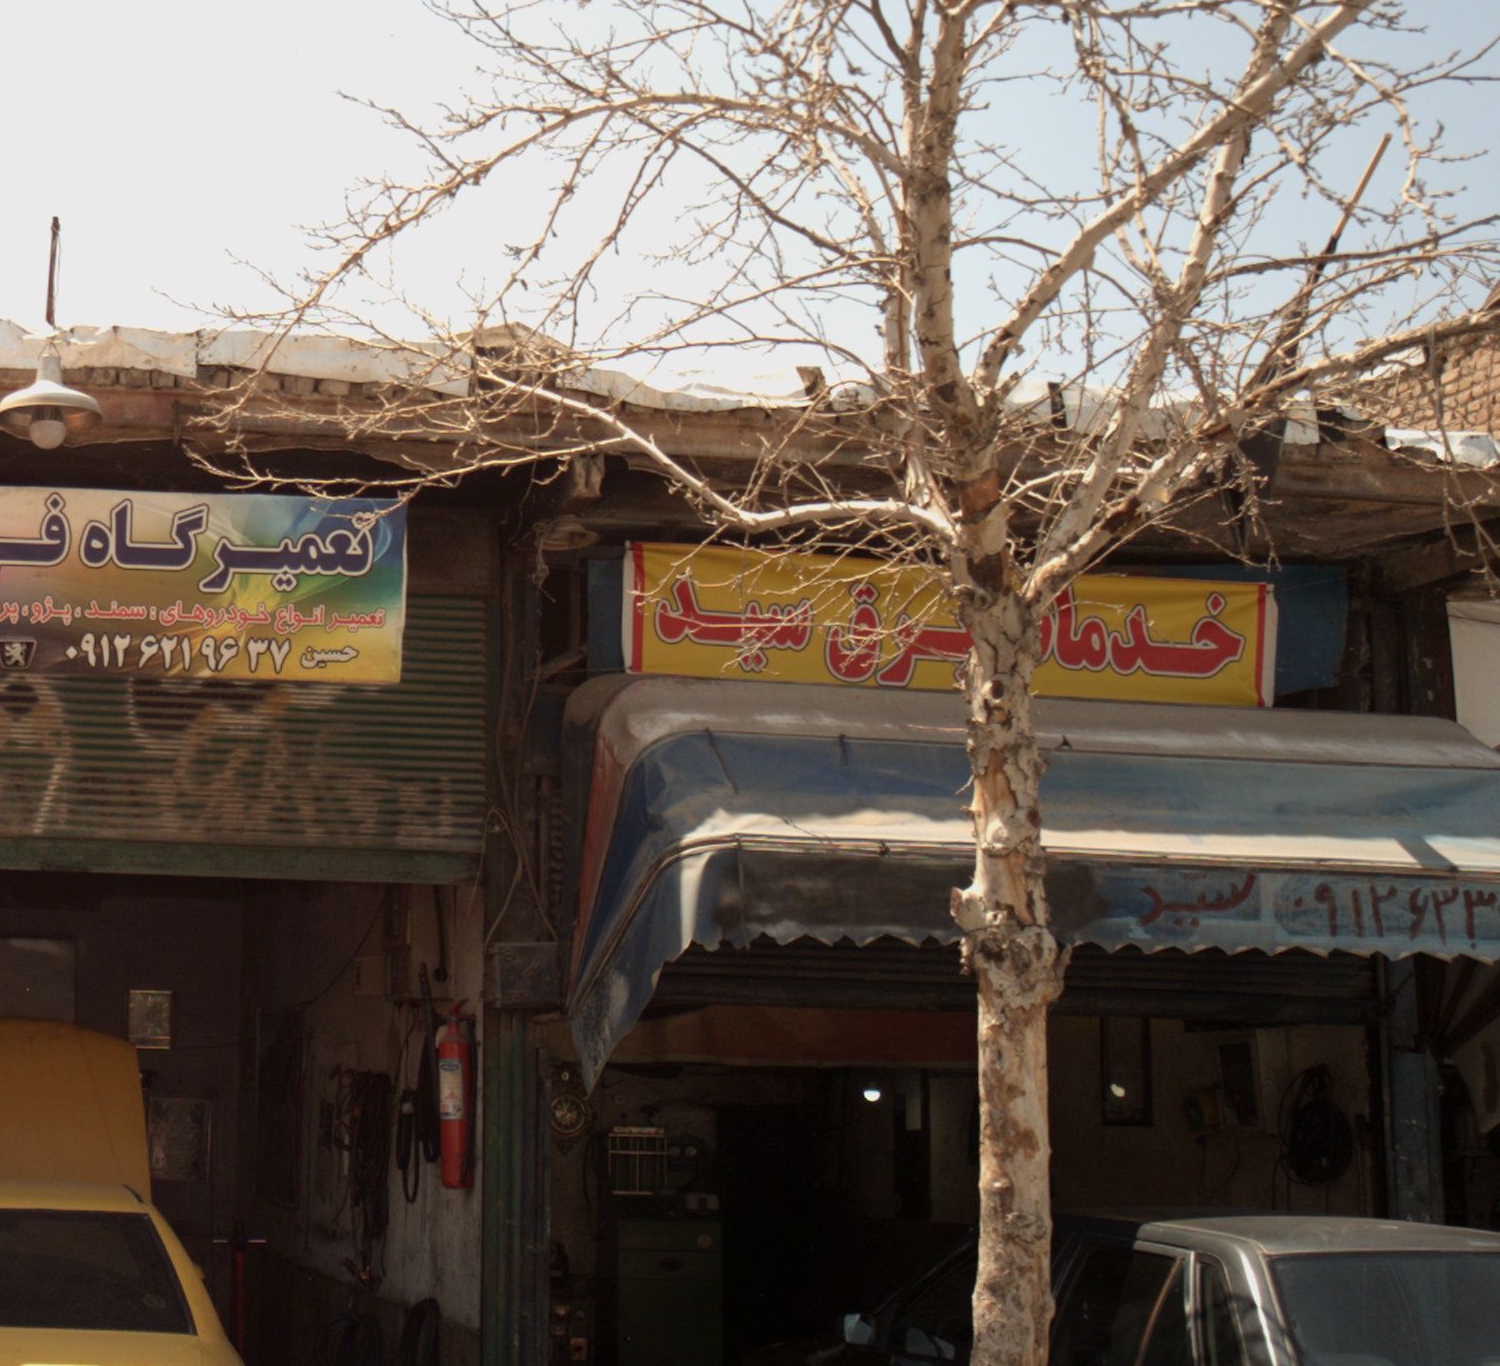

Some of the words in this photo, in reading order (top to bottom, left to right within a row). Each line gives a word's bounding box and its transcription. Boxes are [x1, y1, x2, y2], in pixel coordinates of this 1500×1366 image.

[275, 603, 325, 634] انواع
[325, 607, 385, 633] تعمیر
[655, 577, 812, 673] سید
[1035, 581, 1246, 678] خدما
[300, 644, 359, 669] حسین
[1136, 873, 1257, 927] سید
